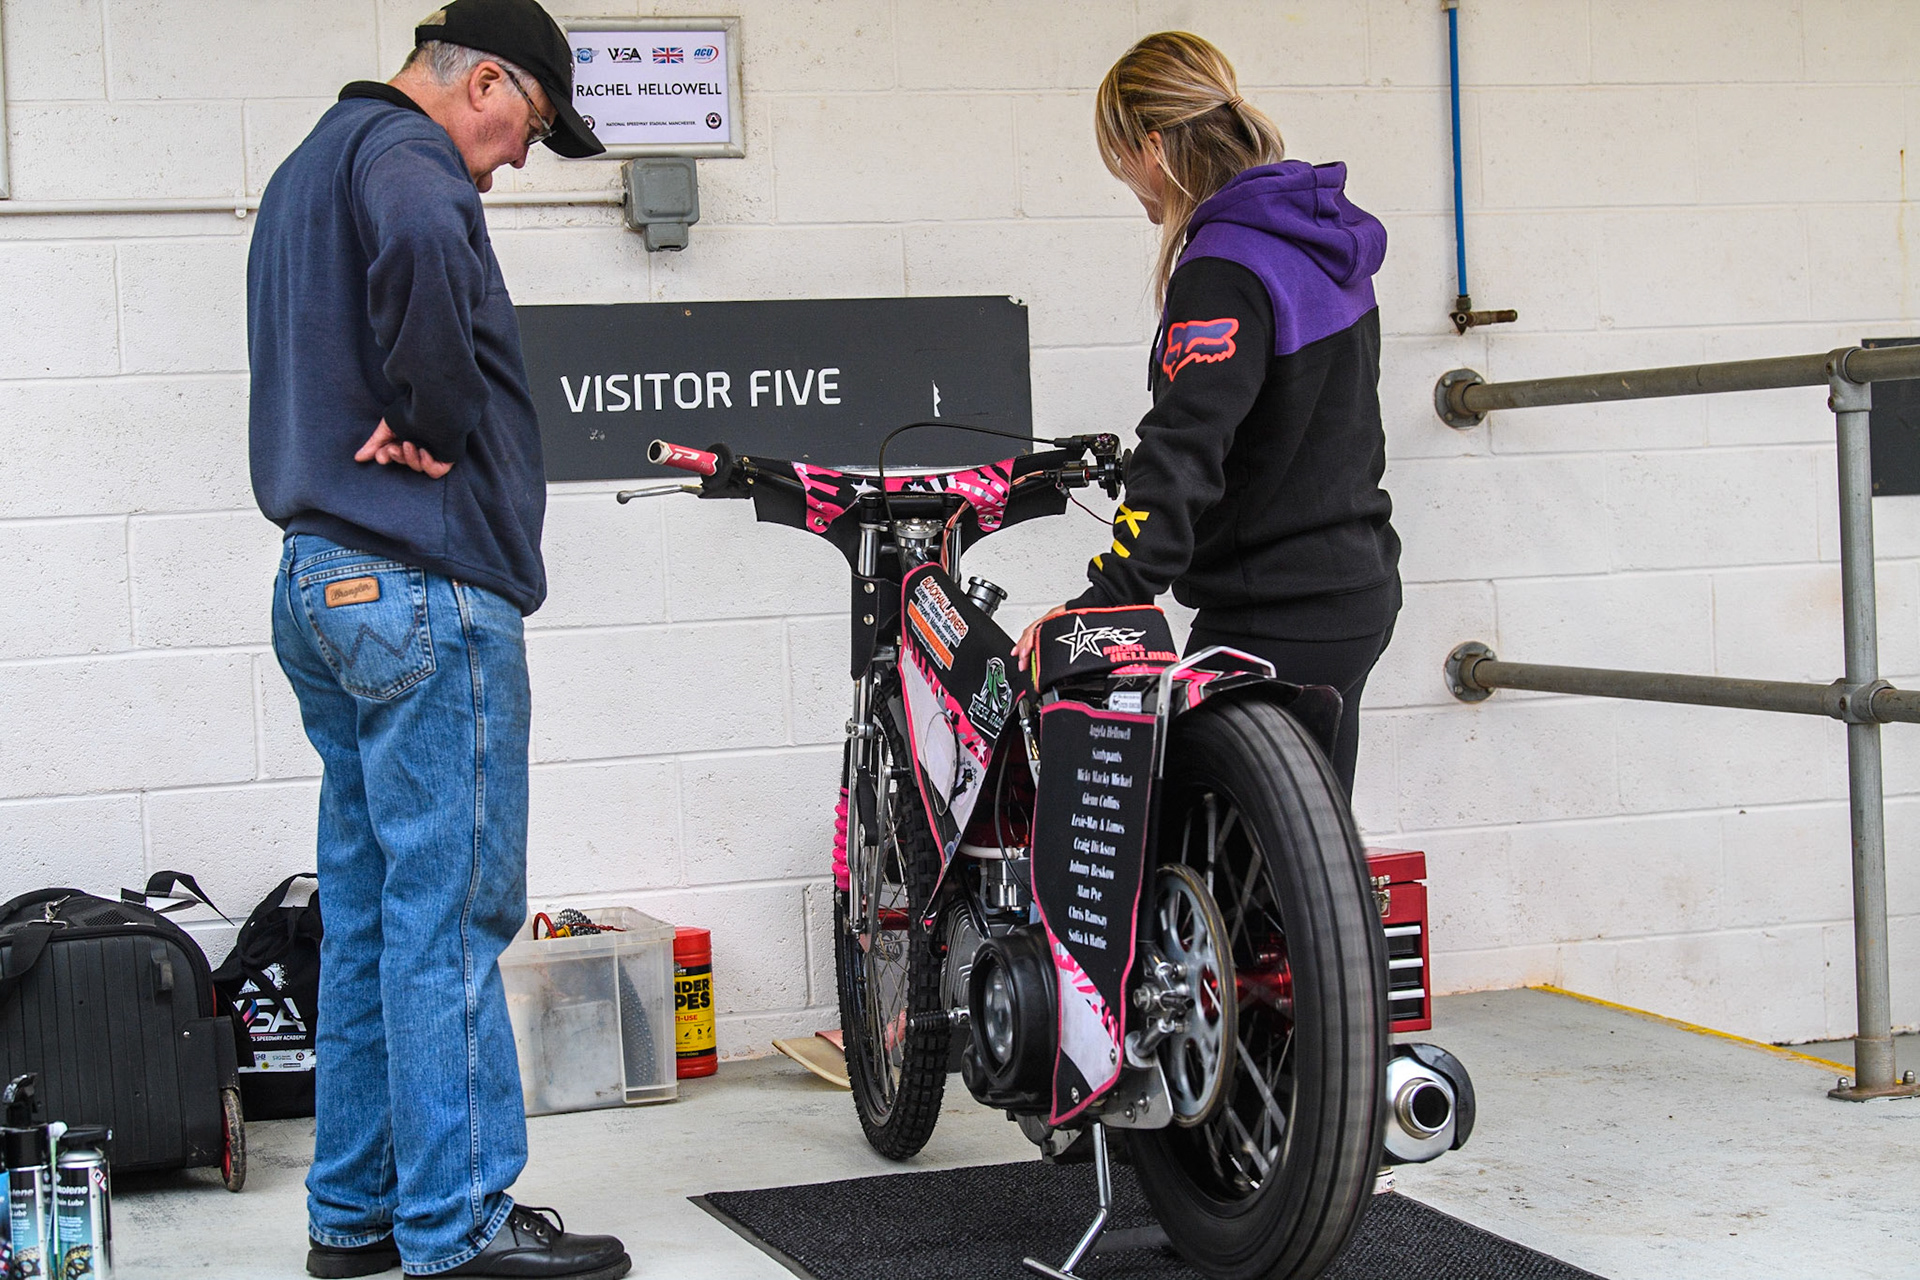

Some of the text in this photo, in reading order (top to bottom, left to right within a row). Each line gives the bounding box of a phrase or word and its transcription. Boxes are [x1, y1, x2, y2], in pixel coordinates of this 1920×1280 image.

[576, 82, 722, 97] RACHEL HELLOWELL
[559, 367, 841, 413] VISITOR FIVE
[330, 581, 373, 601] Wrangler
[921, 576, 951, 613] BLACKHALL
[944, 607, 967, 638] JOINERS
[1111, 772, 1133, 788] Michael
[1082, 792, 1121, 811] Glenn Collins
[1099, 818, 1105, 831] &
[1106, 819, 1125, 835] James
[1073, 836, 1116, 857] Craig Dickson
[1069, 859, 1090, 878] Johnny
[1077, 884, 1103, 903] Alan Pye
[1068, 905, 1108, 929] Chris Ramsay
[1068, 928, 1083, 944] Sofia
[675, 991, 711, 1011] PES
[675, 1014, 698, 1022] TI-USE
